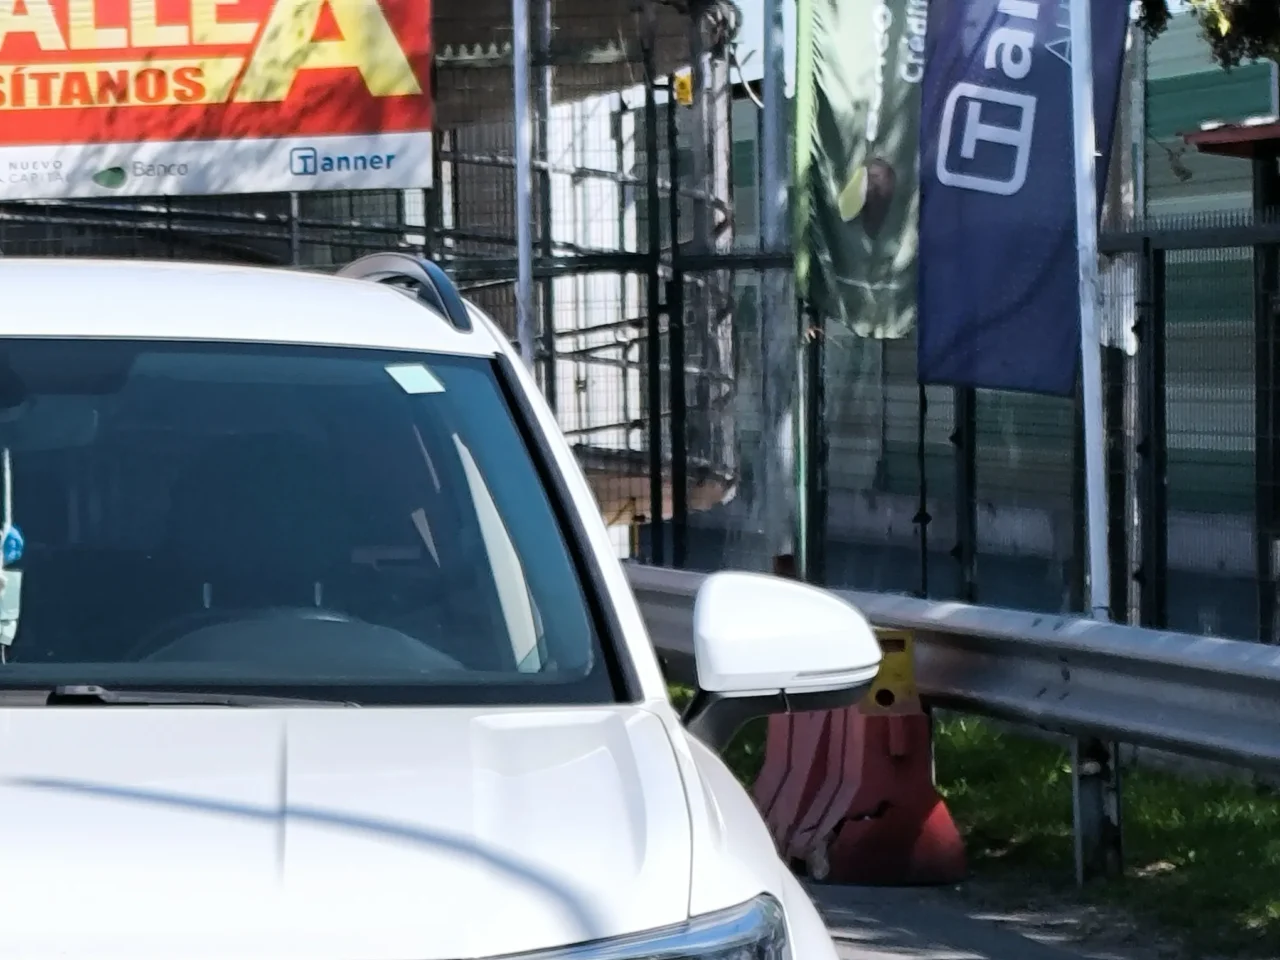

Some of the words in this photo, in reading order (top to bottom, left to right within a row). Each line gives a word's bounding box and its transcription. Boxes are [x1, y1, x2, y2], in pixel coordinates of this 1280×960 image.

[231, 0, 423, 104] A
[8, 160, 63, 171] NUEVO
[132, 161, 189, 177] Banco
[290, 147, 396, 176] Tanner
[8, 172, 71, 184] CAPITA
